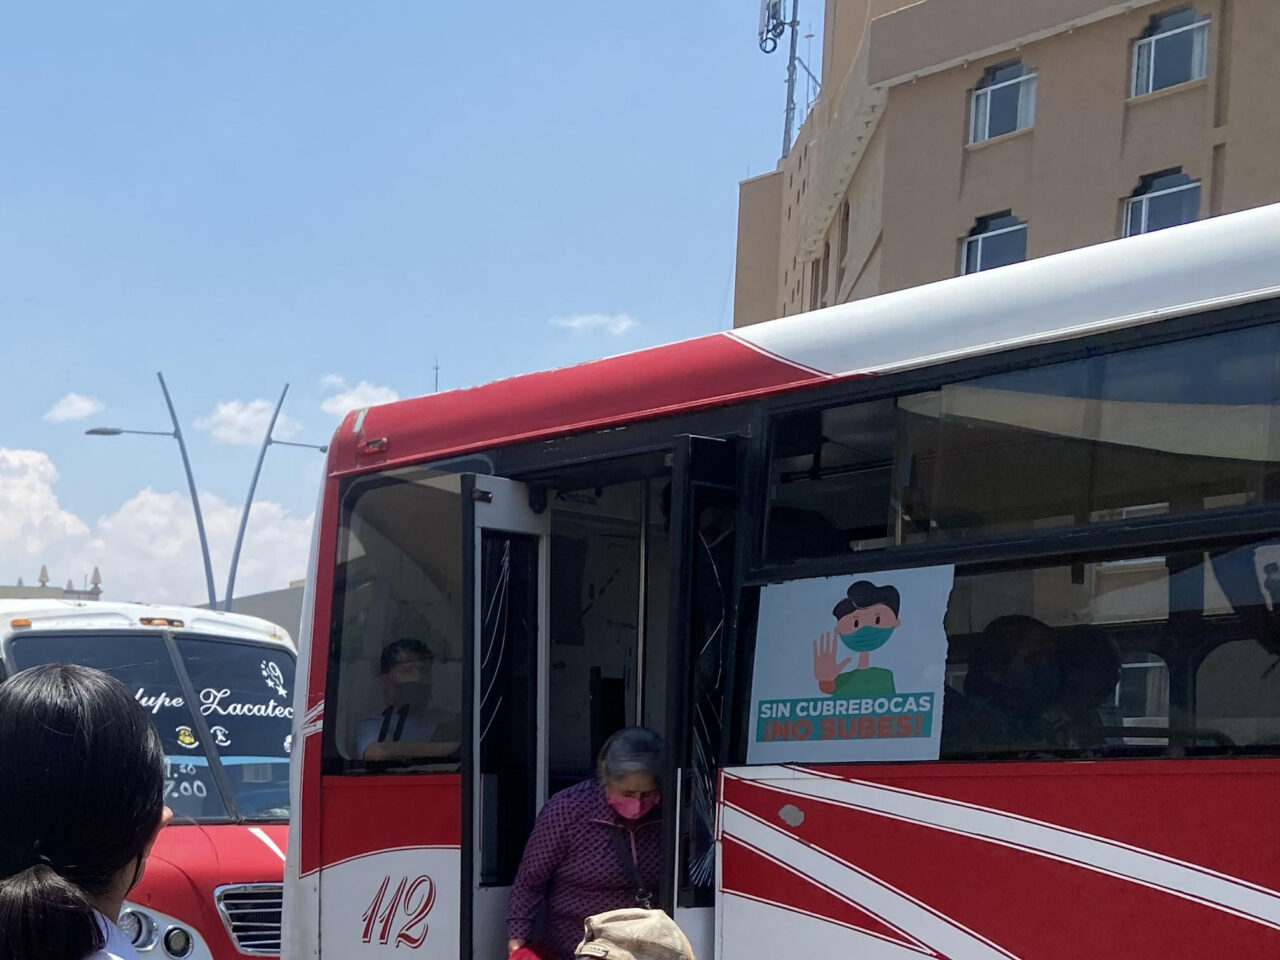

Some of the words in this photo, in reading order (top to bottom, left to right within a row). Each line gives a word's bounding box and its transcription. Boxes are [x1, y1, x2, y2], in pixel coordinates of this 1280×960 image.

[135, 687, 184, 714] lupe
[199, 687, 294, 719] Zacatec
[760, 702, 791, 719] SIN
[796, 695, 932, 717] CUBREBOCAS
[764, 718, 813, 742] ¡NO
[821, 714, 924, 740] SUBES!
[361, 874, 437, 949] 112
